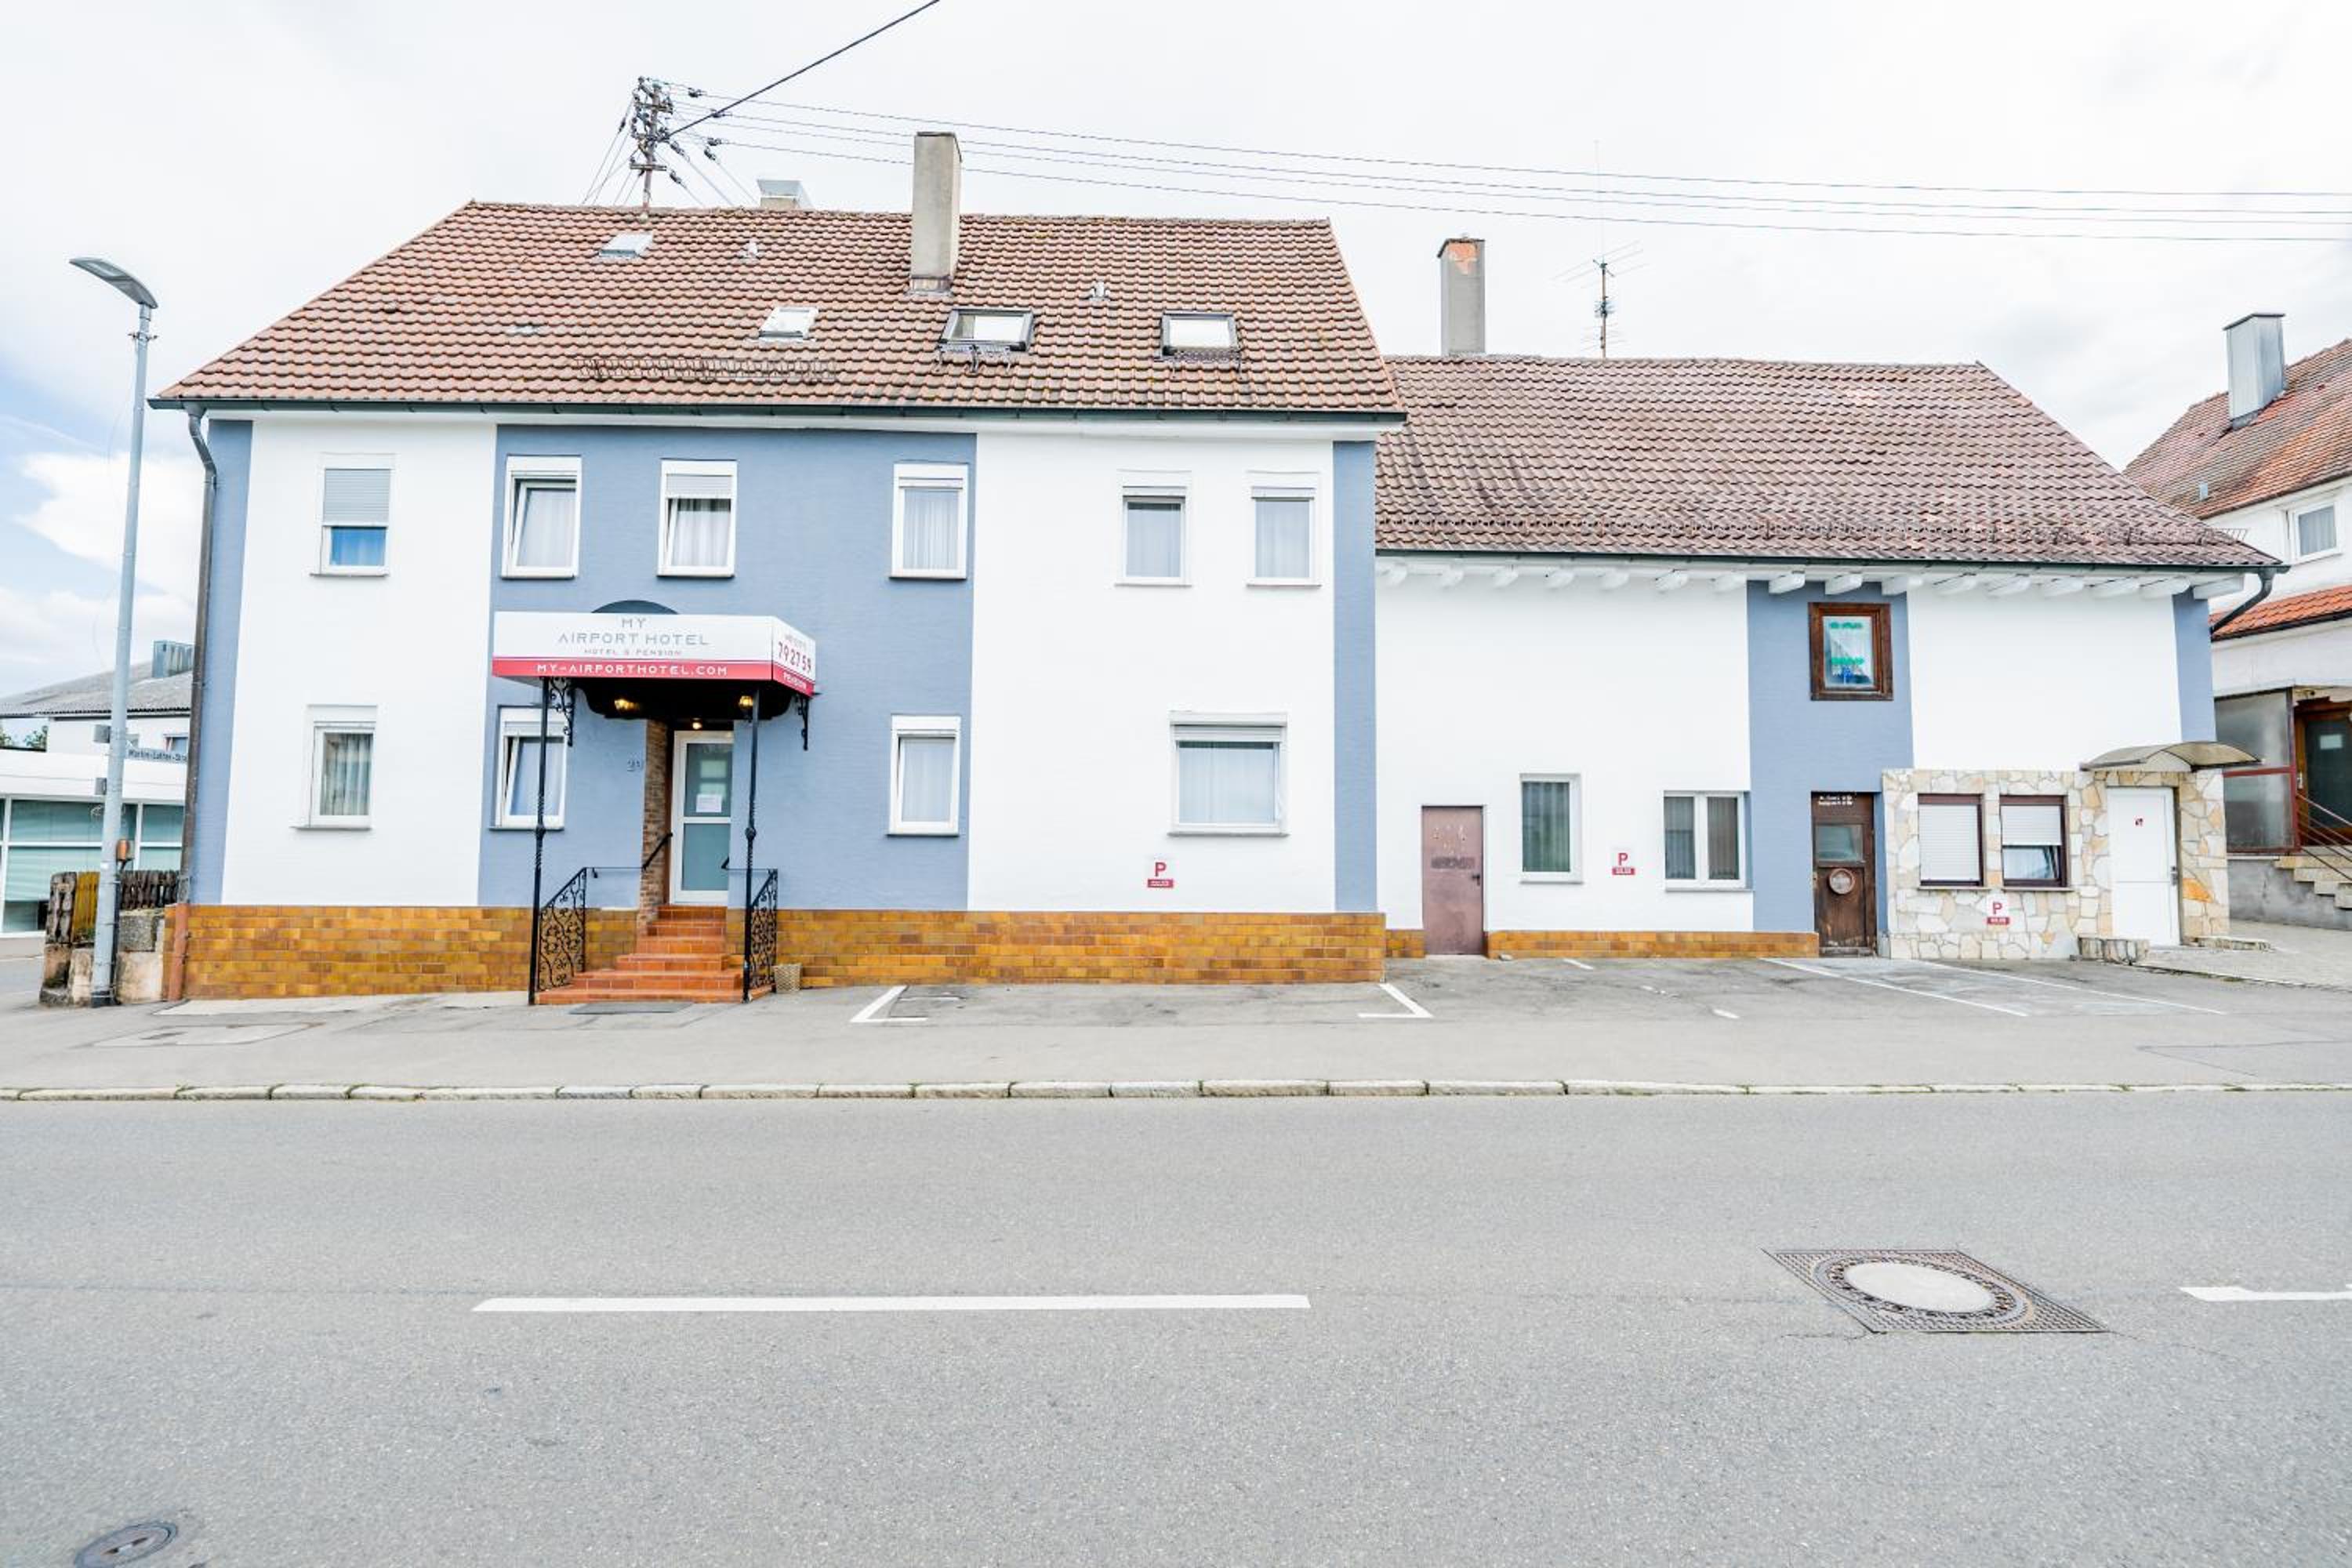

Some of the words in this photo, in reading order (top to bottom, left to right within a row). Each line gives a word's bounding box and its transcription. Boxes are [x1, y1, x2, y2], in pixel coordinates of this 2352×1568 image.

[622, 618, 646, 628] MY
[558, 633, 639, 644] AIRPORT
[646, 634, 709, 645] HOTEL
[537, 664, 728, 676] MY-AIRPORTHOTEL.COM
[1618, 852, 1628, 866] P
[1155, 862, 1167, 877] P
[1992, 902, 2002, 915] P
